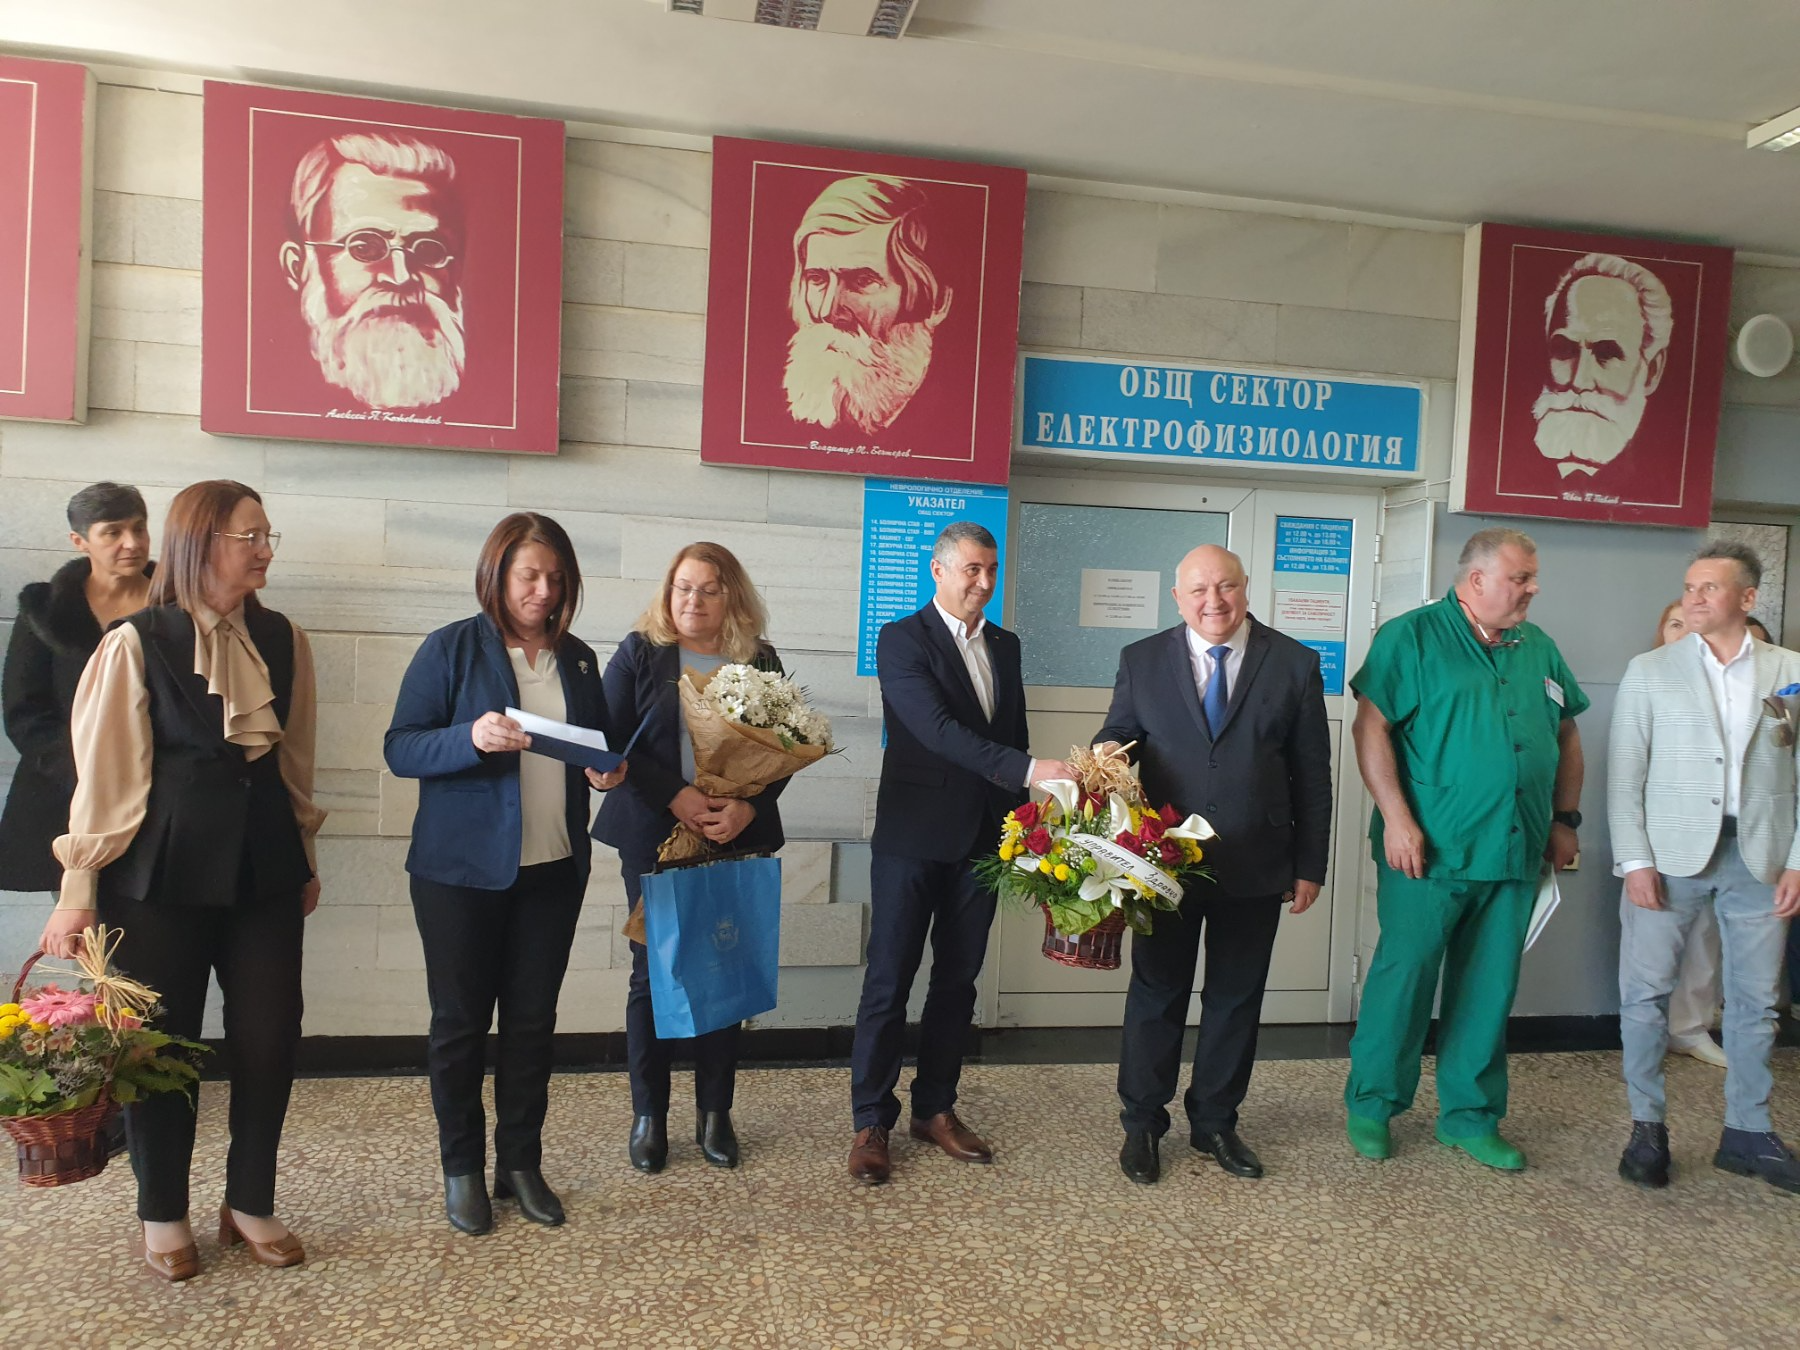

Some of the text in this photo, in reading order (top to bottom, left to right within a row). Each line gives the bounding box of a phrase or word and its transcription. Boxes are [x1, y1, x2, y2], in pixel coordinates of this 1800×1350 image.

[1120, 366, 1333, 411] ОБЩ СЕКТОР
[1036, 411, 1404, 466] ЕЛЕКТРОФИЗИОЛОГИЯ
[908, 496, 966, 510] УКАЗАТЕЛ
